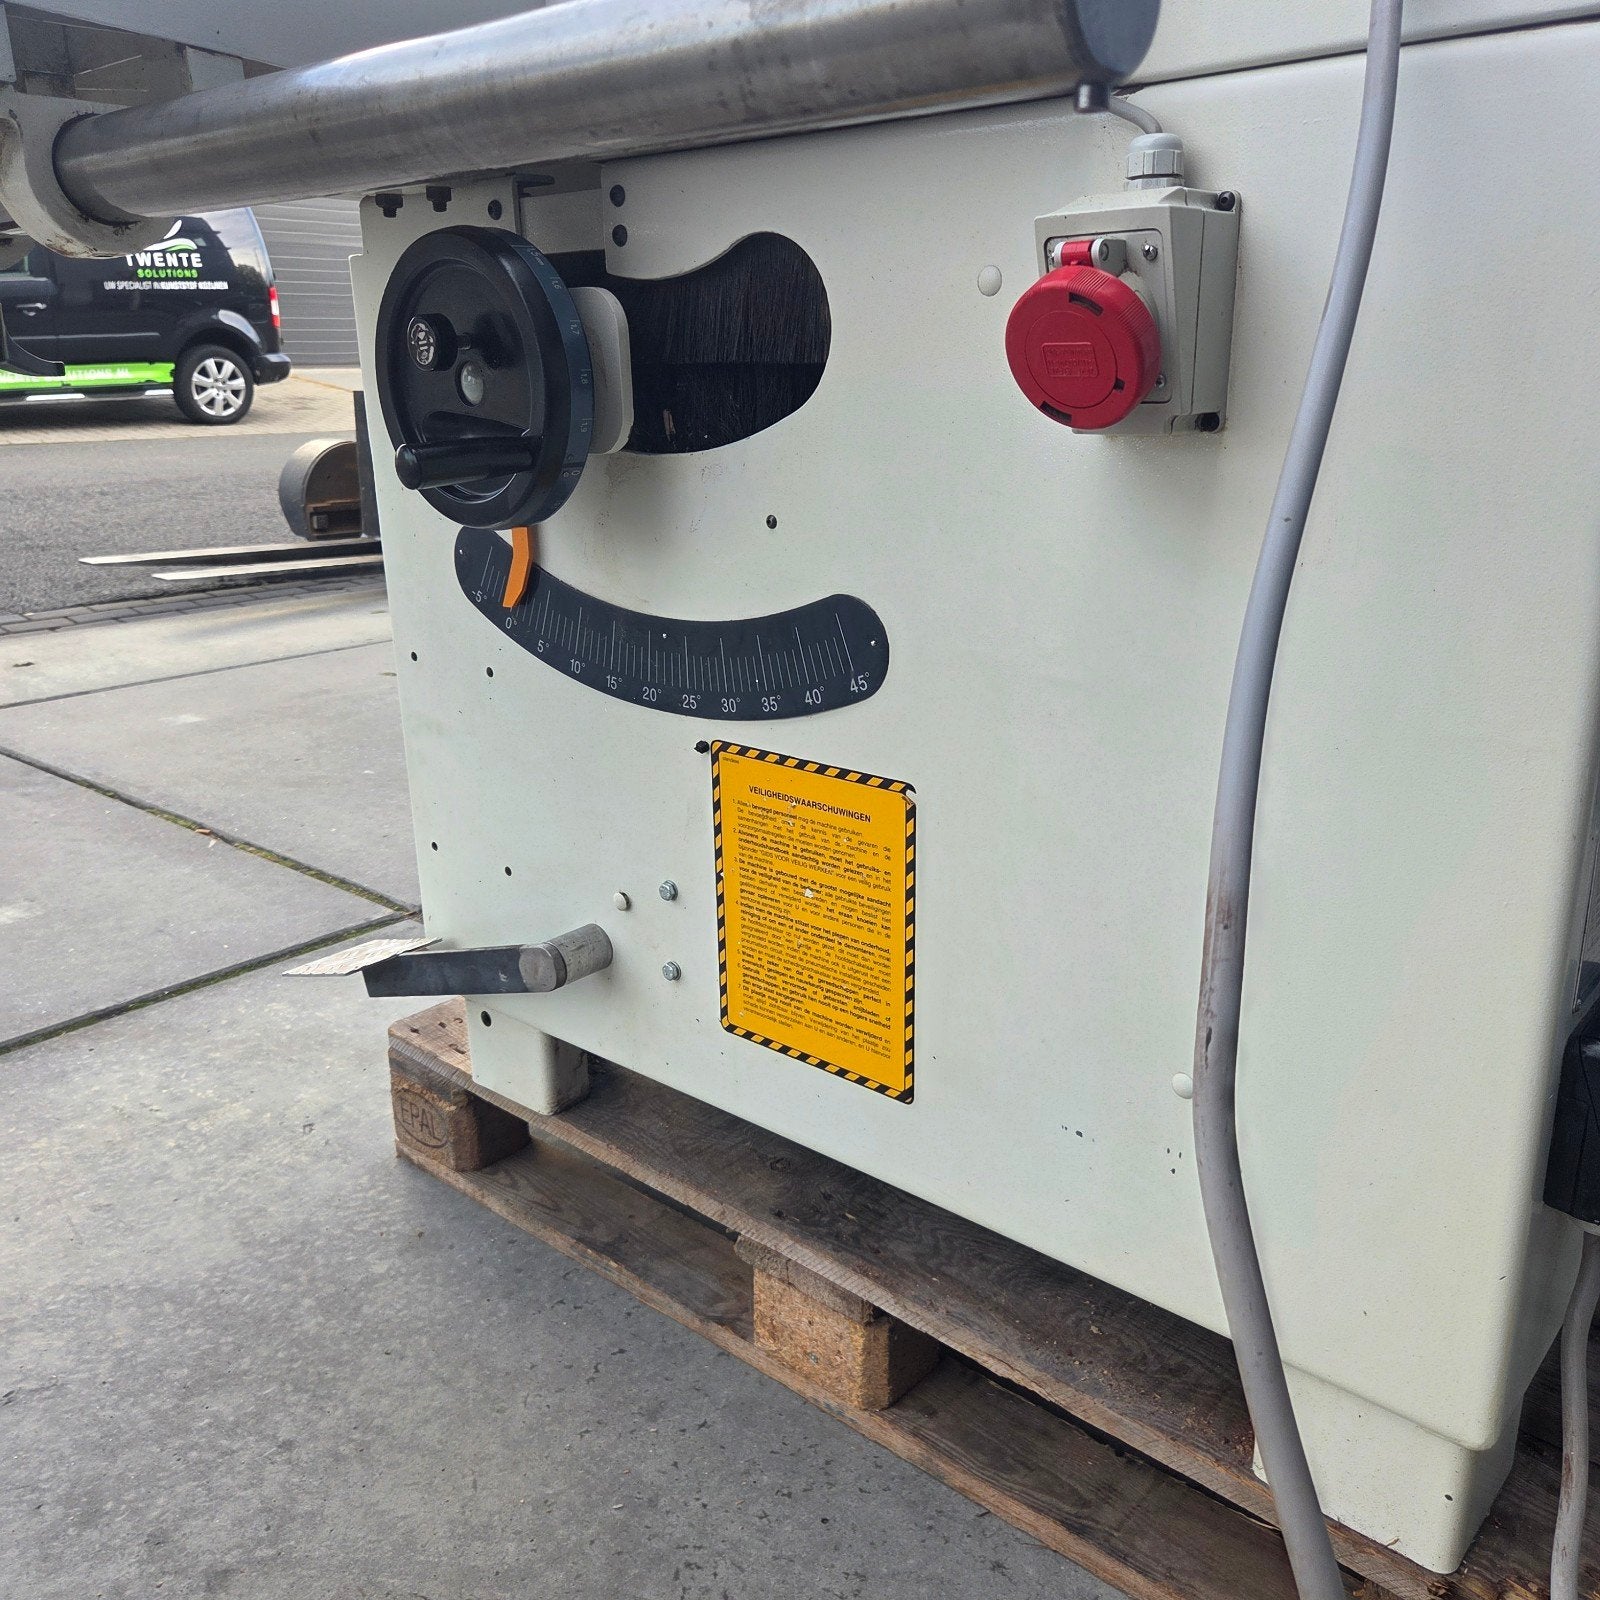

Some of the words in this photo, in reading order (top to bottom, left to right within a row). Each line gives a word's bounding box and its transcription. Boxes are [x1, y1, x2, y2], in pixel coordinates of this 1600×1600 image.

[126, 252, 203, 268] TWENTE
[136, 268, 198, 278] SOLUTIONS
[472, 590, 488, 602] -5°
[506, 617, 518, 629] 0°
[537, 640, 550, 652] 5°
[570, 658, 586, 674] 10°
[606, 674, 622, 690] 15°
[642, 686, 662, 702] 20°
[682, 694, 701, 710] 25°
[721, 698, 741, 712] 30°
[761, 694, 782, 712] 35°
[804, 686, 825, 706] 40°
[850, 672, 870, 694] 45°
[749, 785, 870, 822] VEILIGHEIDSWAARSCHUWINGEN
[399, 1096, 442, 1142] EPAL
